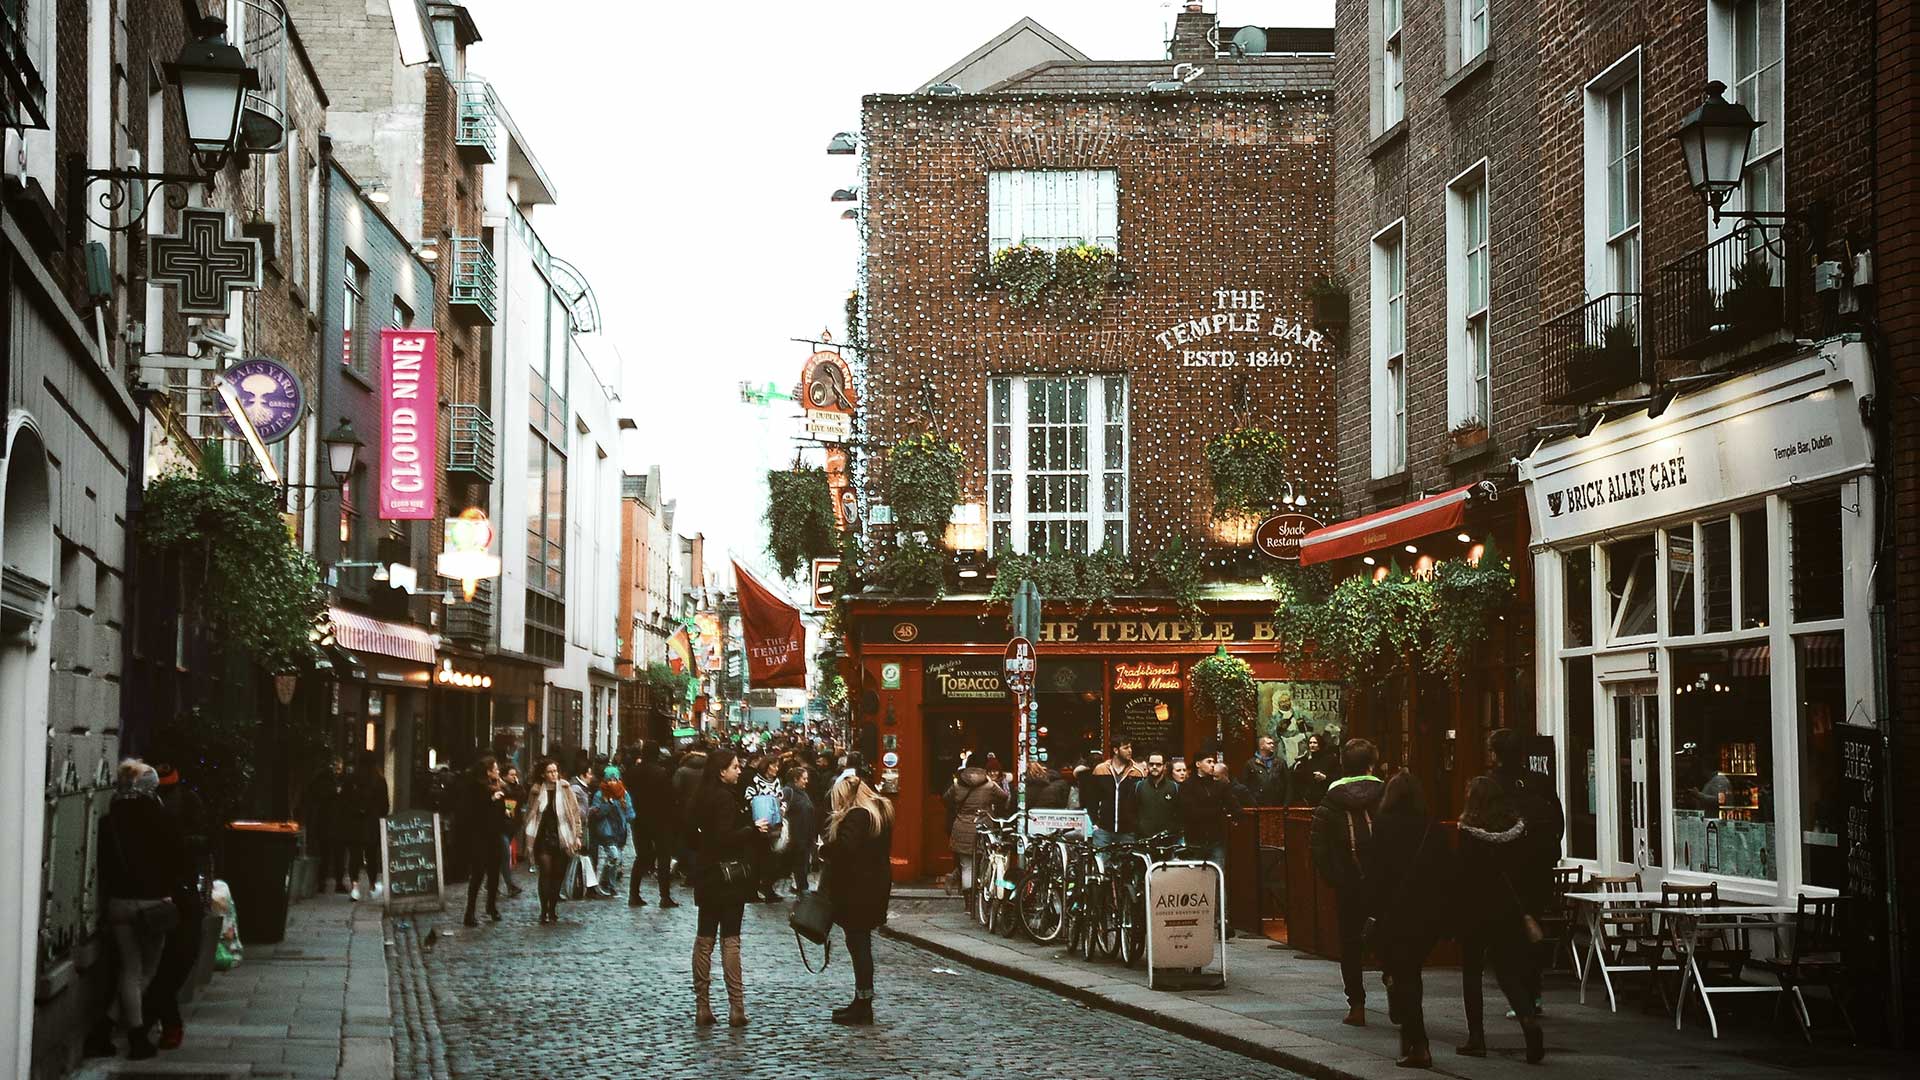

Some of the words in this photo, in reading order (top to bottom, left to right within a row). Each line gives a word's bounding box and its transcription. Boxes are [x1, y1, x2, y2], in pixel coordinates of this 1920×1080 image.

[1214, 290, 1266, 310] THE
[1155, 312, 1261, 352] TEMPLE
[1271, 316, 1324, 352] BAR
[1183, 350, 1239, 367] ESTD.
[1249, 351, 1293, 367] 1840
[392, 337, 426, 400] NINE
[269, 366, 296, 399] YARD
[390, 407, 424, 493] CLOUD
[1773, 446, 1797, 461] Temple
[1796, 443, 1811, 457] Bar,
[1812, 436, 1834, 451] Dublin
[1567, 480, 1605, 513] BRICK
[1608, 466, 1646, 502] ALLEY
[1649, 448, 1688, 492] CAFÉ
[1278, 520, 1306, 537] Shack
[897, 625, 913, 637] 48
[1037, 622, 1081, 642] HE
[1092, 621, 1236, 642] TEMPLE
[750, 641, 799, 658] TEMPLE
[765, 638, 785, 646] THE
[765, 655, 788, 666] BAR
[1116, 662, 1178, 678] Traditional
[937, 673, 999, 696] TOBACCO
[1114, 678, 1143, 691] Irish
[1147, 678, 1181, 690] Music
[1309, 700, 1339, 713] BAR
[1155, 892, 1209, 908] ARIOSA
